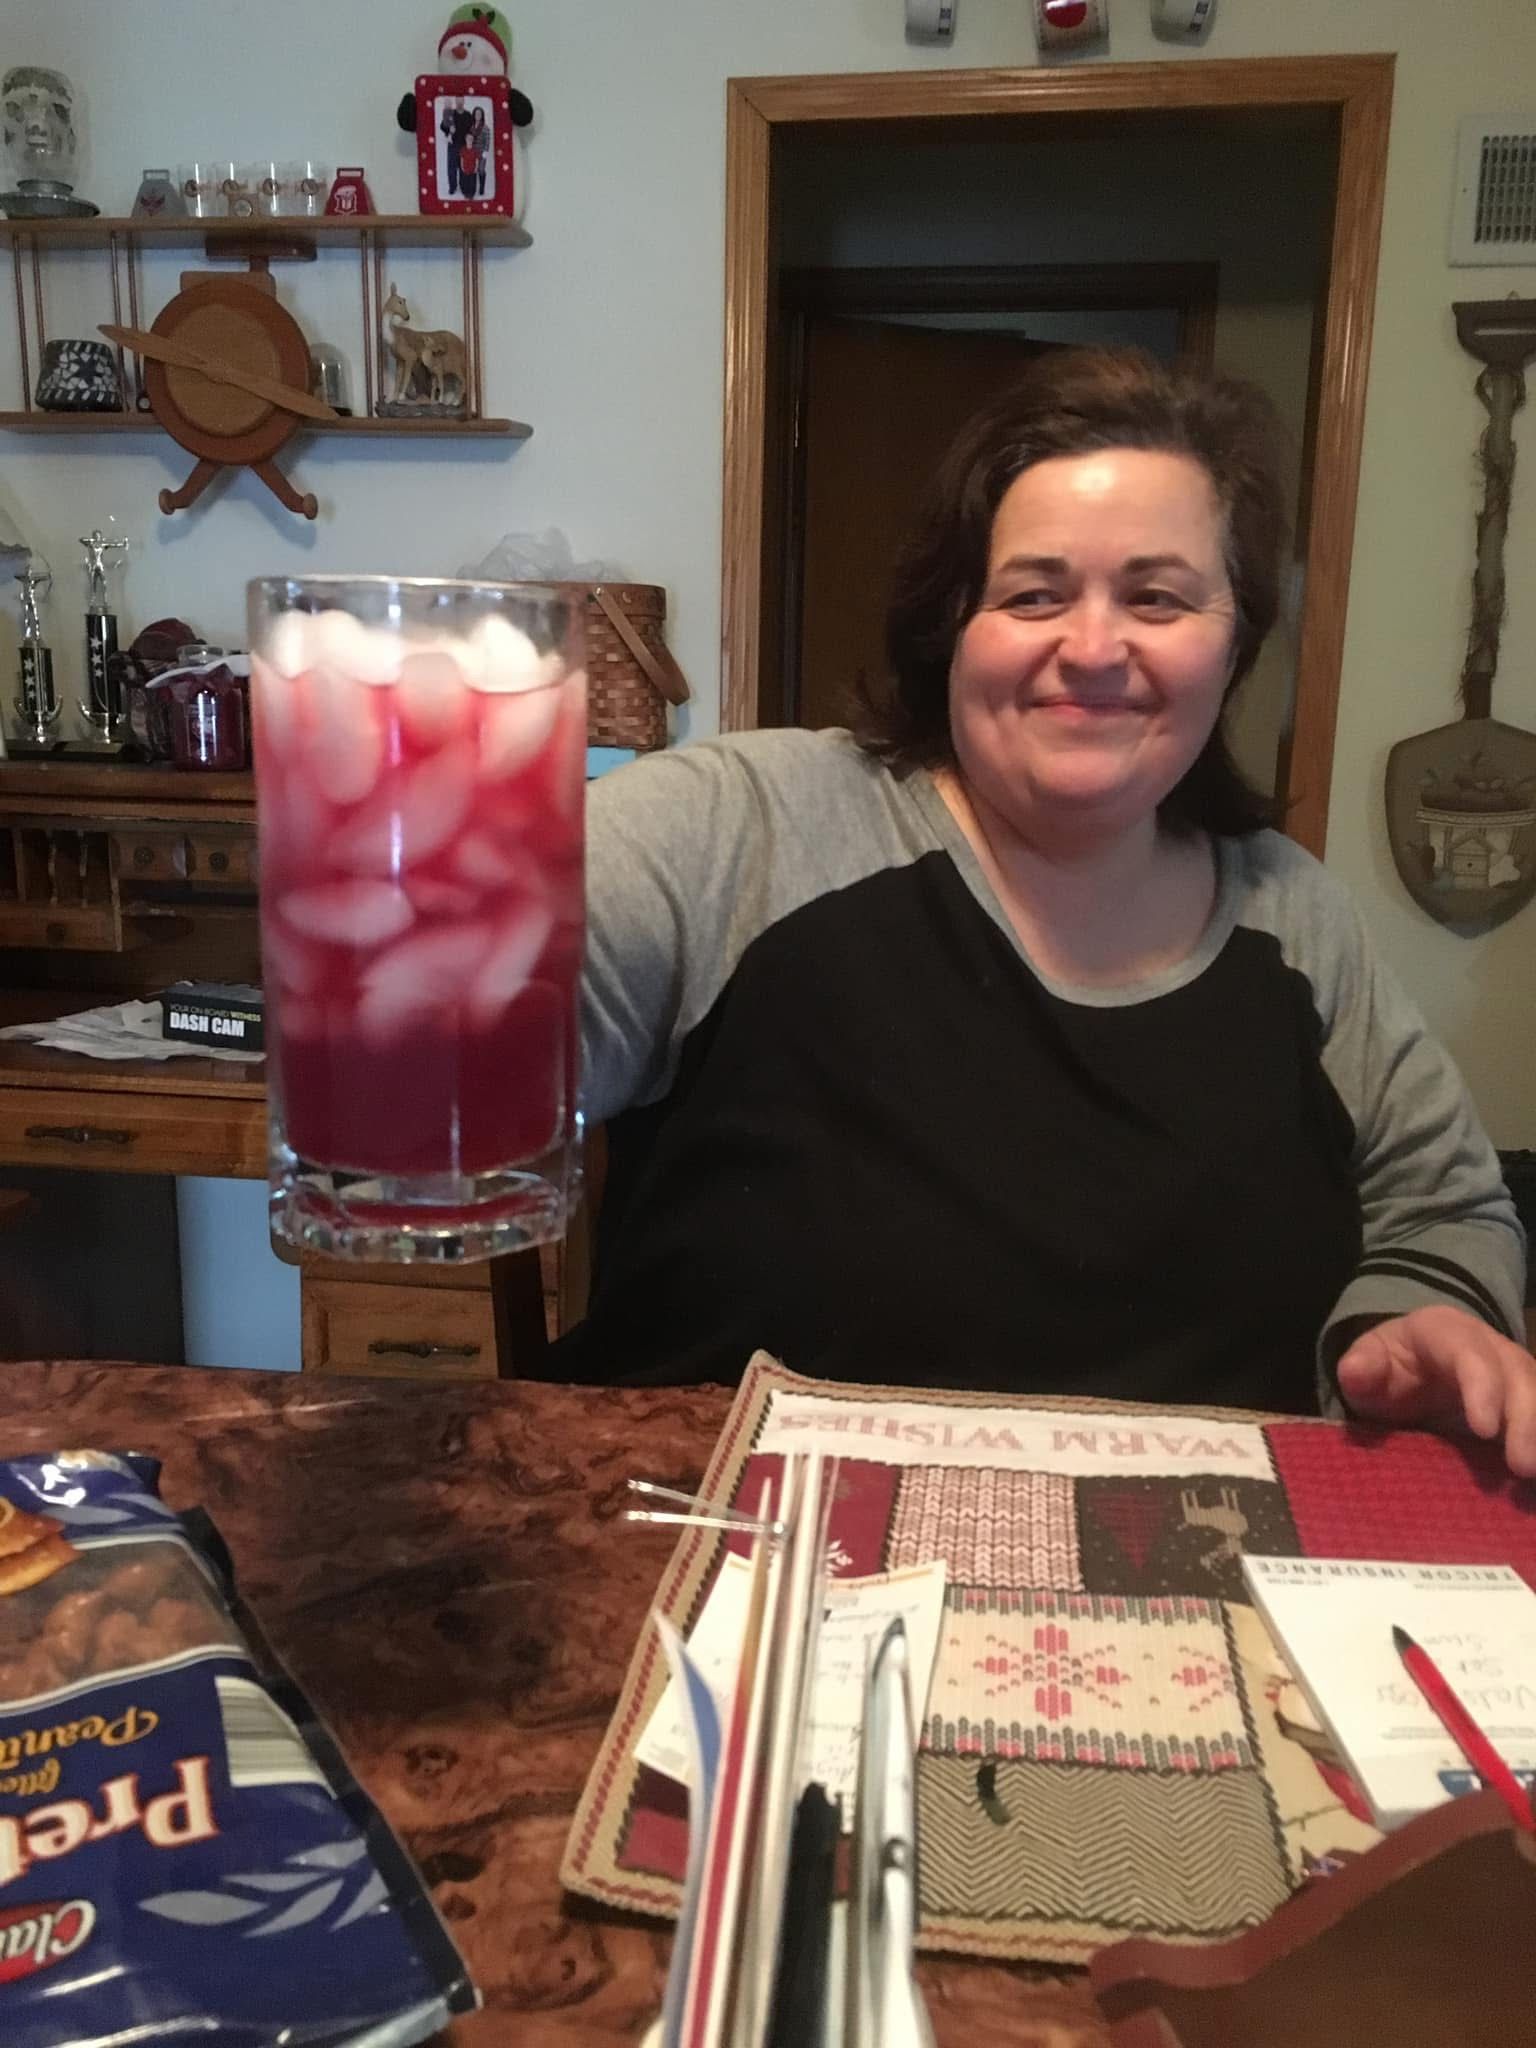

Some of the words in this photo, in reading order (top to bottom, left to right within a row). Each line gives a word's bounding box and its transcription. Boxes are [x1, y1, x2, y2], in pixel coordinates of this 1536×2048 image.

[170, 1011, 209, 1033] DASH
[211, 1016, 245, 1037] CAM
[779, 1413, 1023, 1452] WISHES
[1053, 1429, 1252, 1459] WARM
[1258, 1562, 1407, 1579] INSURANCE
[0, 1899, 97, 1964] Cla
